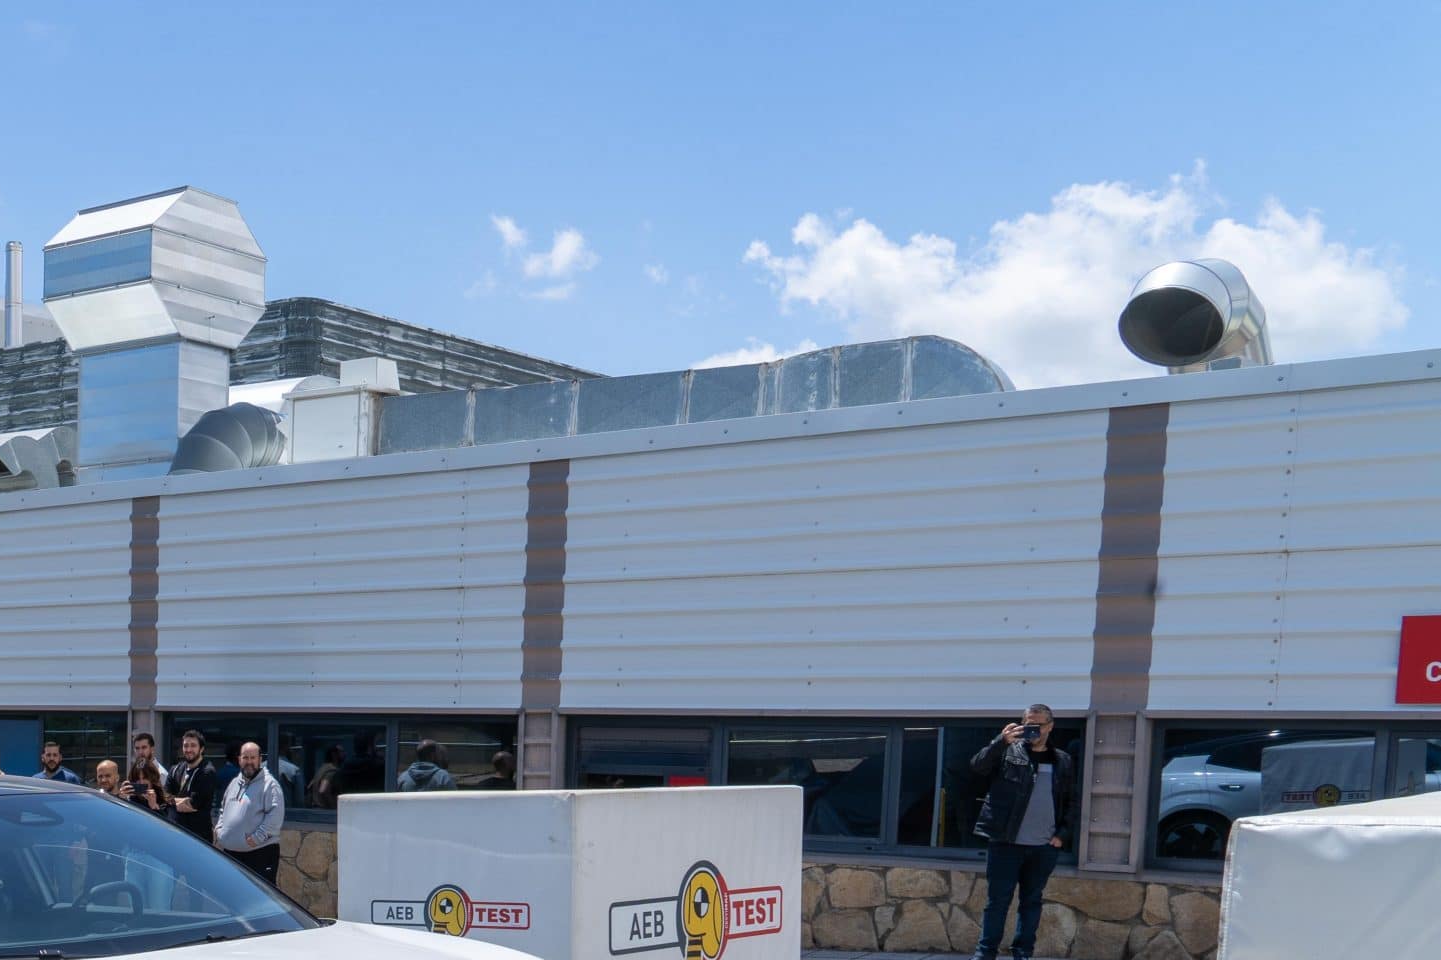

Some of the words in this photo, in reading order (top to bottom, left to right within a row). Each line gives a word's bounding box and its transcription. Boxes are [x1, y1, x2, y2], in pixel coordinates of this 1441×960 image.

[386, 906, 414, 920] AEB
[475, 908, 523, 923] TEST
[629, 910, 665, 940] AEB
[732, 896, 776, 926] TEST
